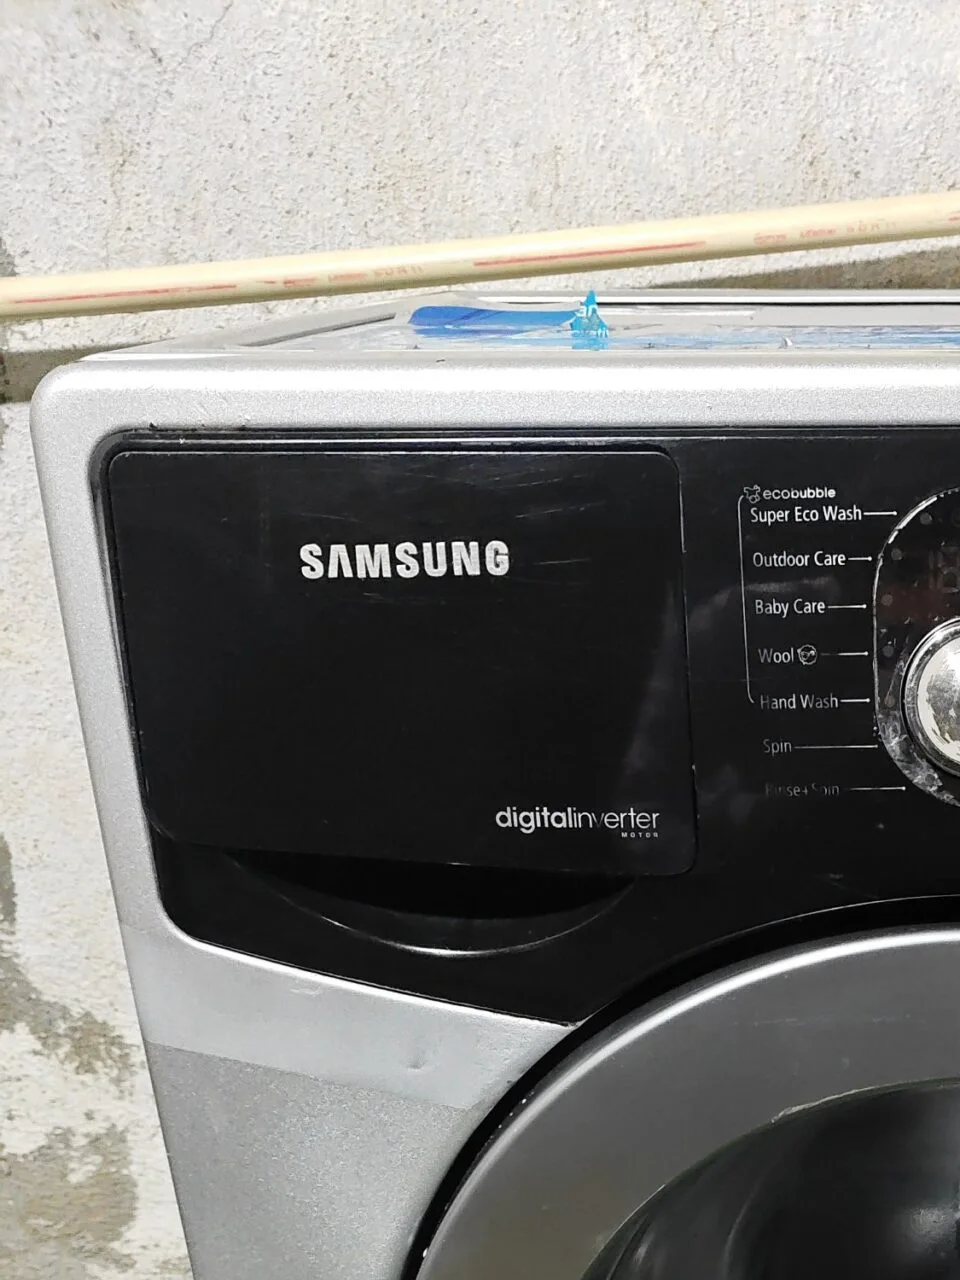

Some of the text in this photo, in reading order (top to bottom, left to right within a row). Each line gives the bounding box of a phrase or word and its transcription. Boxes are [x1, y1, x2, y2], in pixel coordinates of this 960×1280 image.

[762, 486, 836, 500] ecobubble
[750, 504, 862, 526] Super Eco Wash
[299, 540, 510, 580] SAMSUNG
[753, 550, 846, 567] Outdoor Care
[755, 598, 826, 619] Baby Care
[758, 647, 795, 663] Wool
[760, 693, 839, 710] Hand Wash
[763, 738, 793, 757] Spin
[495, 806, 660, 834] digitalinverter
